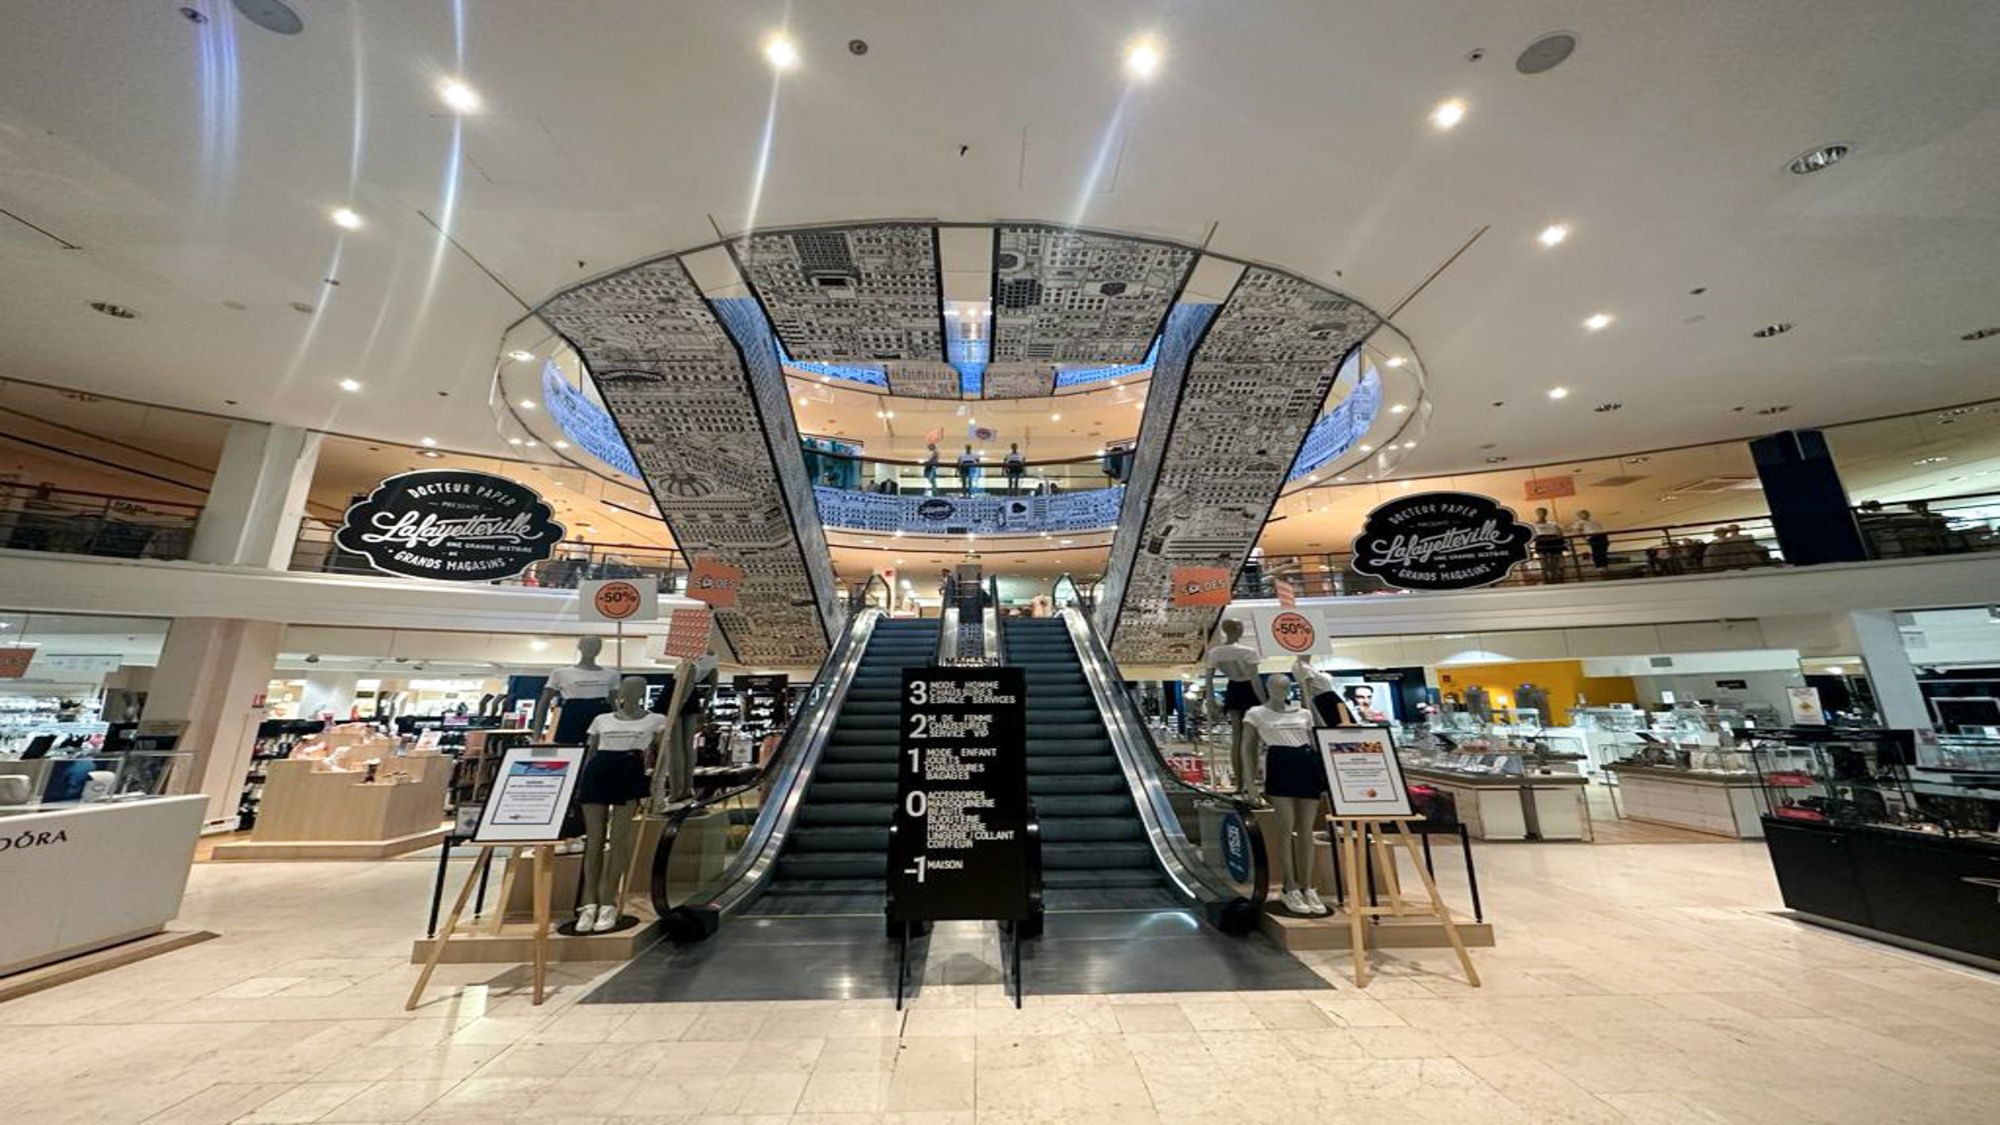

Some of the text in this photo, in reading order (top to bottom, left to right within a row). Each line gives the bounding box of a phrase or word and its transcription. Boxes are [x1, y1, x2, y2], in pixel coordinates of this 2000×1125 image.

[407, 483, 517, 507] DOCTEUR PAPER
[1388, 503, 1478, 525] DOCTEUR PAPER
[361, 510, 544, 548] Lafayetteville
[1369, 519, 1514, 567] Lafayetteville
[393, 550, 506, 571] GRANDS MAGASINS
[1398, 563, 1491, 581] GRANDS MAGASINS
[599, 591, 638, 603] -50%
[1275, 622, 1311, 635] -50%
[909, 680, 928, 705] 3
[929, 681, 999, 689] MODE HOMME
[929, 695, 1016, 704] ESPACE SERVICES
[909, 713, 928, 738] 2
[964, 715, 993, 723] FEMME
[929, 729, 965, 738] SERVICE
[908, 748, 919, 773] 1
[924, 756, 960, 764] JOUETS
[925, 748, 997, 756] MODE ENFANT
[906, 790, 927, 817] 0
[974, 831, 1014, 840] COLLANT
[904, 856, 926, 882] -1
[927, 860, 963, 869] MAISON
